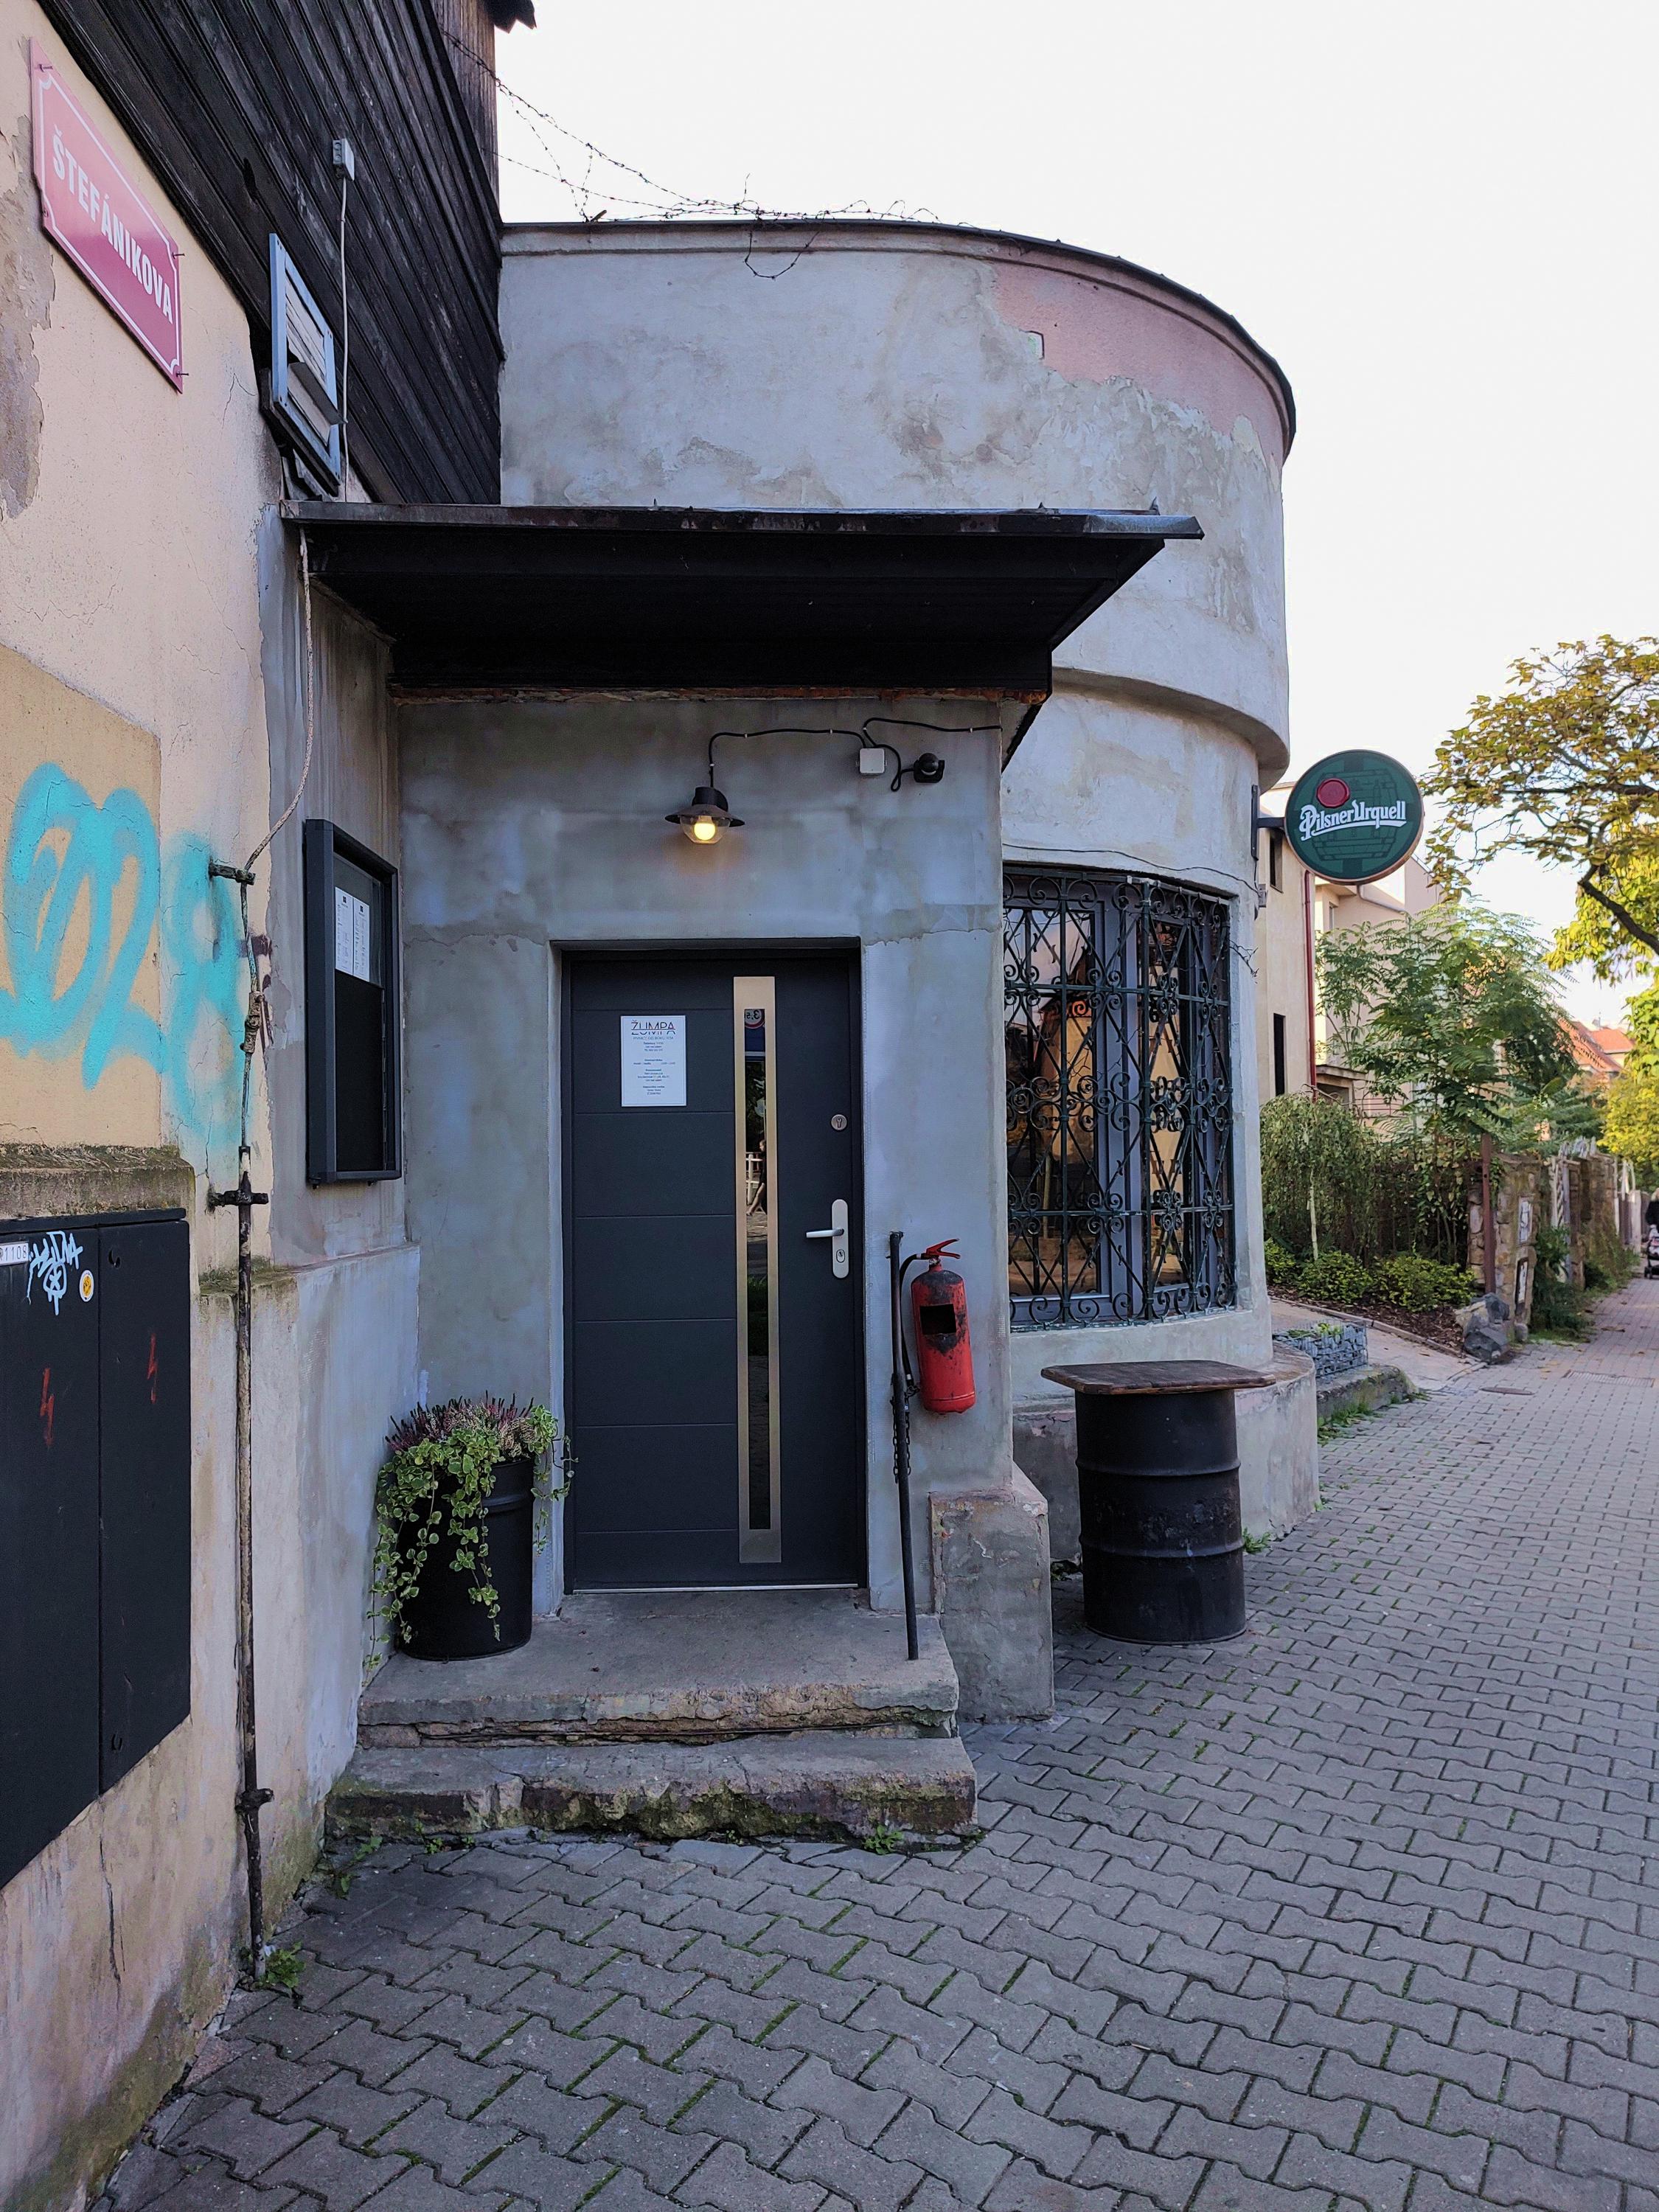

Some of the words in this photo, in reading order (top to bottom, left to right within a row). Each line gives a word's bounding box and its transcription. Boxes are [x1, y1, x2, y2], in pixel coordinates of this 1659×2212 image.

[52, 123, 173, 324] ŠTEFÁNIKOVA
[1298, 804, 1354, 841] Pilsner
[1352, 799, 1407, 829] Urquell
[630, 1019, 676, 1035] ŽUMPA
